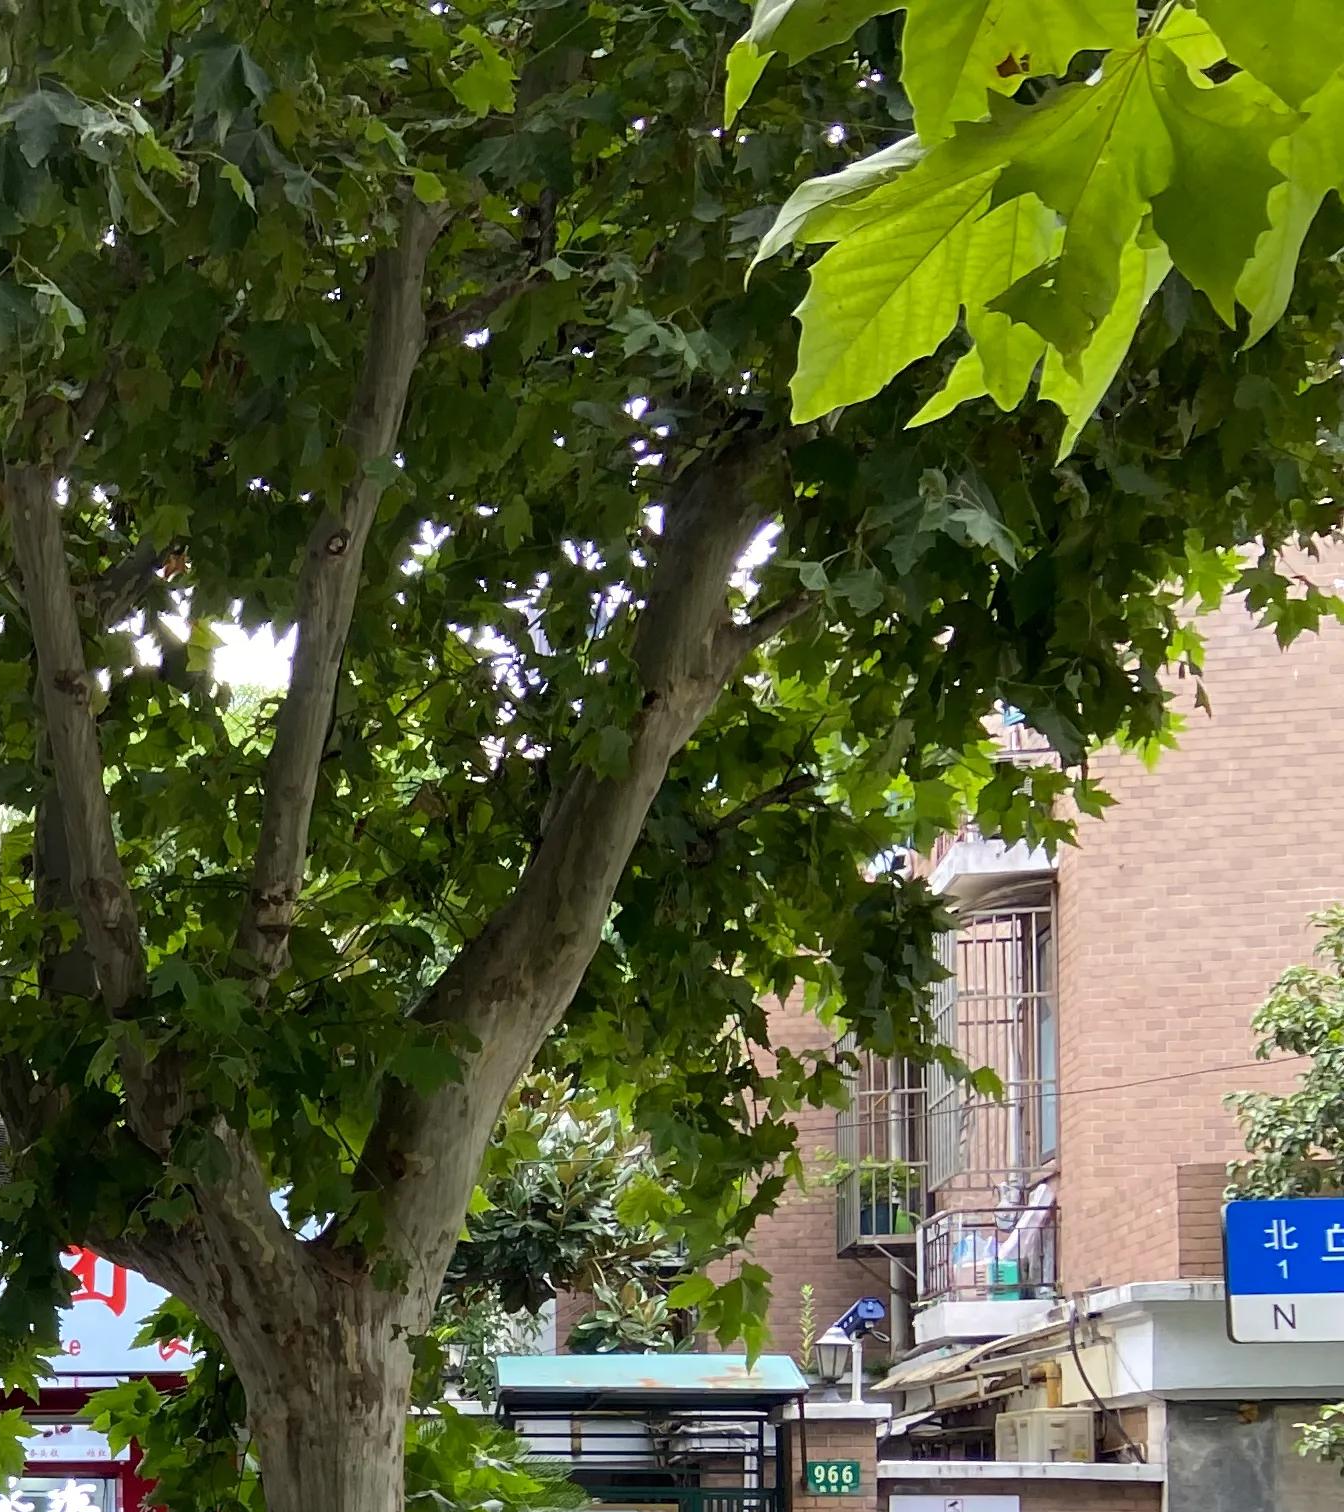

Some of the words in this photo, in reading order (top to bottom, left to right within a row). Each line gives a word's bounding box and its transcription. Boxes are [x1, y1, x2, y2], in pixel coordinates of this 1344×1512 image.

[1263, 1218, 1299, 1250] 北
[1273, 1303, 1296, 1330] N
[814, 1465, 854, 1484] 966
